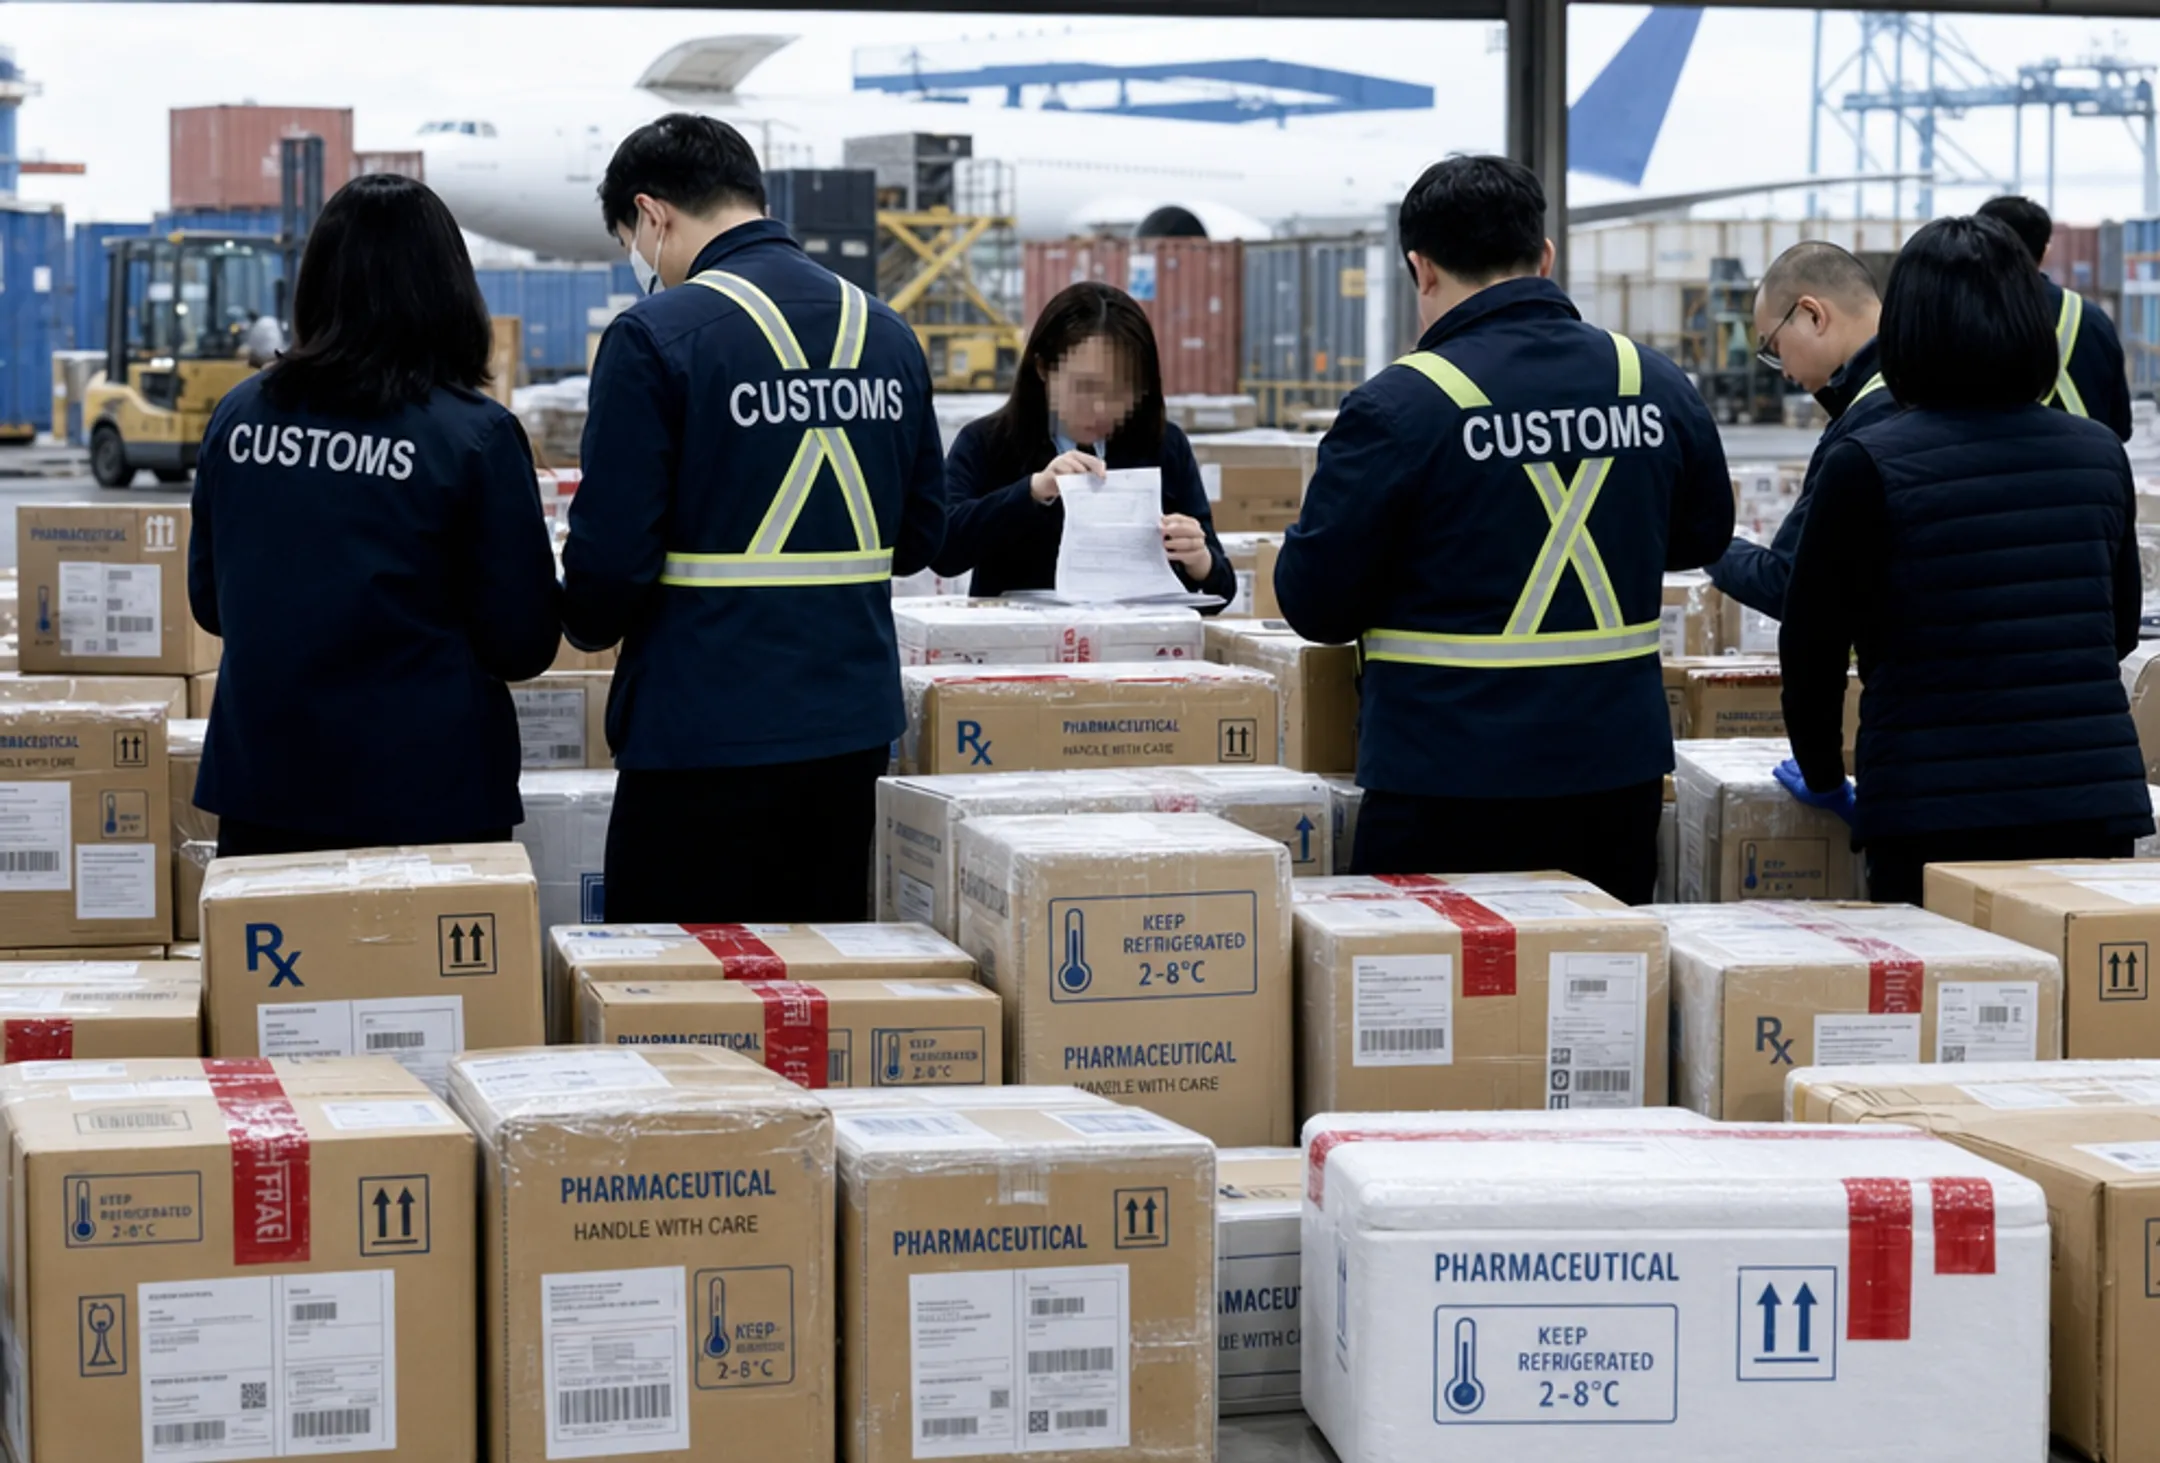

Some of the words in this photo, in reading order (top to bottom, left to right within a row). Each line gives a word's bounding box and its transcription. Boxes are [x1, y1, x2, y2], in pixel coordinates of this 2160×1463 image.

[730, 378, 903, 428] CUSTOMS
[1463, 403, 1665, 461] CUSTOMS
[228, 423, 415, 480] CUSTOMS
[1063, 718, 1180, 733] PHARMACEUTICAL
[1143, 914, 1185, 930] KEEP
[1123, 933, 1246, 953] REFRIGERATED
[1139, 960, 1205, 985] 2-8°C
[1064, 1041, 1236, 1070] PHARMACEUTICAL
[1138, 1078, 1175, 1093] WITH
[1179, 1076, 1219, 1092] CARE
[561, 1169, 776, 1204] PHARMACEUTICAL
[574, 1220, 650, 1241] HANDLE
[655, 1217, 703, 1237] WITH
[708, 1215, 758, 1235] CARE
[893, 1224, 1088, 1256] PHARMACEUTICAL
[1435, 1252, 1680, 1282] PHARMACEUTICAL
[1243, 1330, 1284, 1348] WITH
[1538, 1327, 1588, 1346] KEEP
[1518, 1352, 1654, 1372] REFRIGERATED
[1539, 1381, 1620, 1408] 2-8°C
